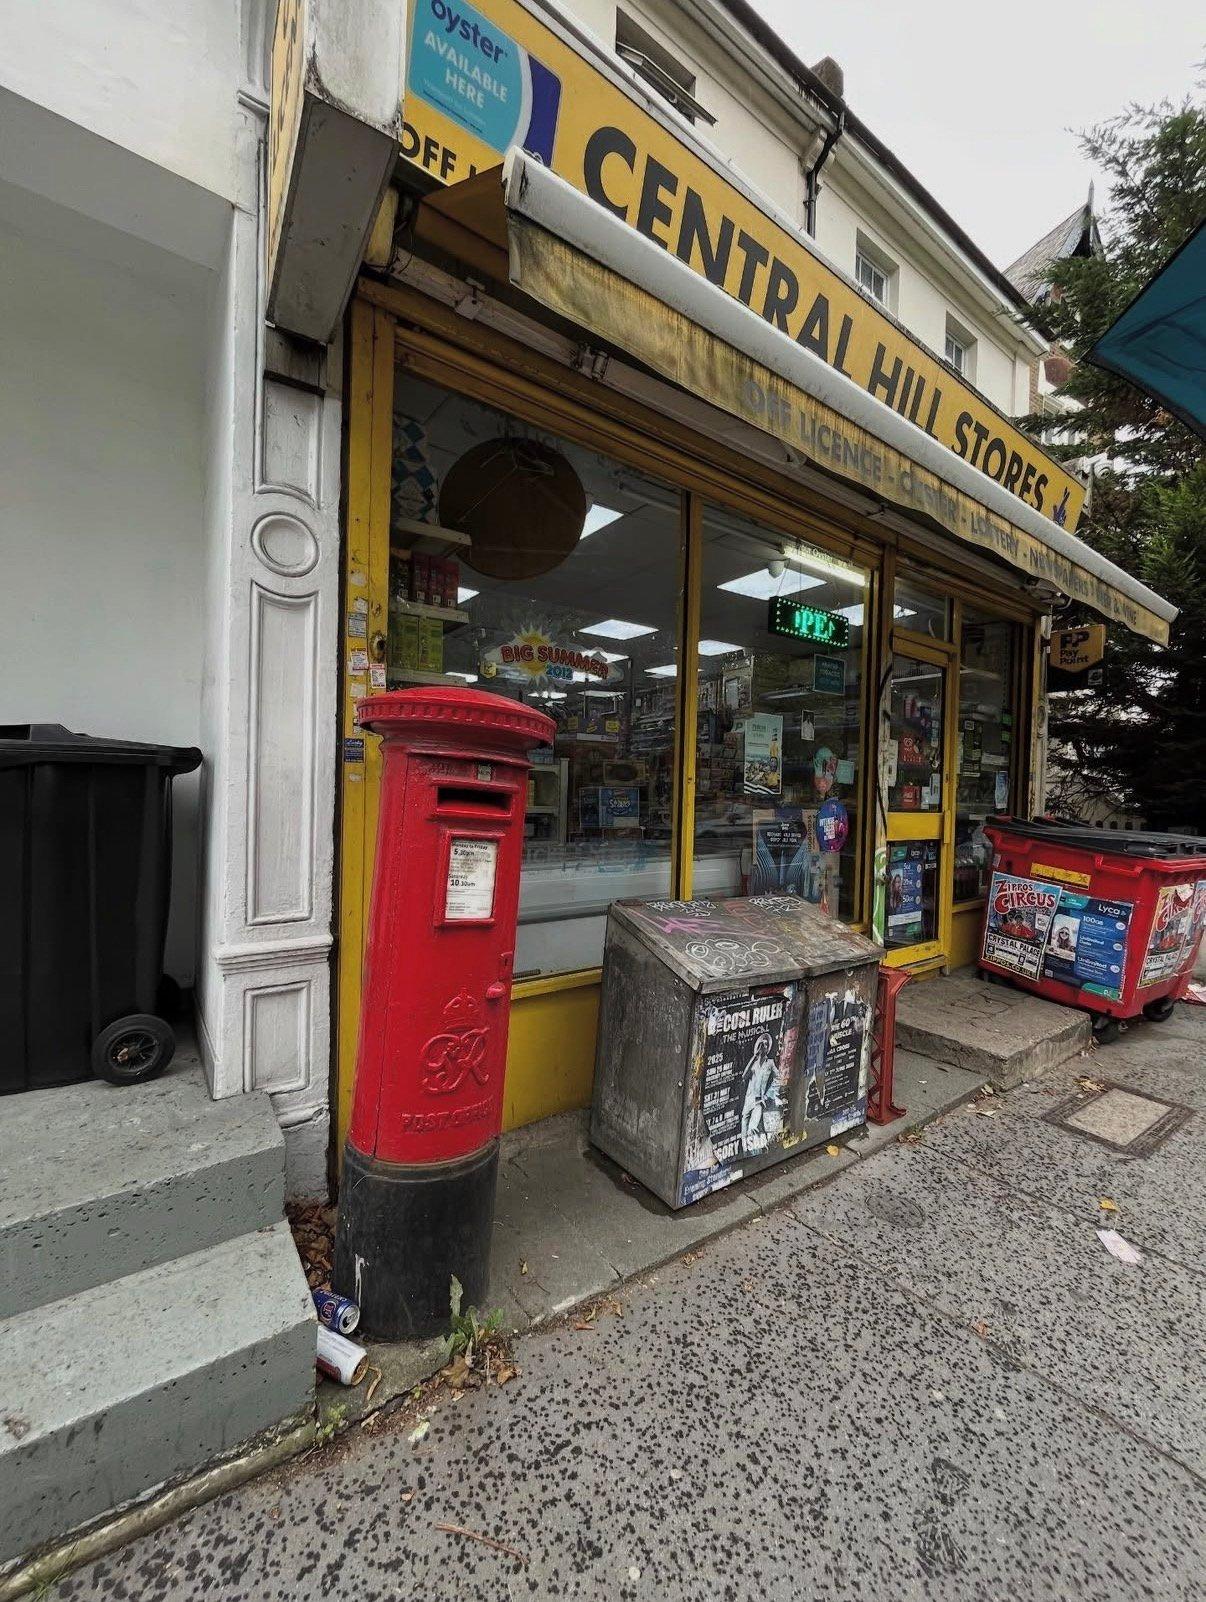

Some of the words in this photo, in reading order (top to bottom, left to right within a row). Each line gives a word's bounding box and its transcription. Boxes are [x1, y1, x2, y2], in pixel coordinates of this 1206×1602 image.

[431, 0, 503, 63] oyster
[424, 30, 508, 103] AVAILABLE
[445, 67, 484, 109] HERE
[399, 121, 457, 181] OFF
[584, 126, 853, 380] CENTRAL
[868, 342, 942, 441] HILL
[951, 411, 1048, 511] STORES
[799, 410, 883, 484] LICENCE
[500, 644, 534, 663] BIG
[537, 645, 609, 679] SUMMER
[994, 891, 1056, 915] CIRCUS
[995, 880, 1033, 894] ZIPPOS
[1099, 904, 1121, 915] Lyca
[988, 932, 1018, 950] CRYSTAL
[752, 1002, 783, 1026] RULER
[723, 1032, 737, 1044] THE
